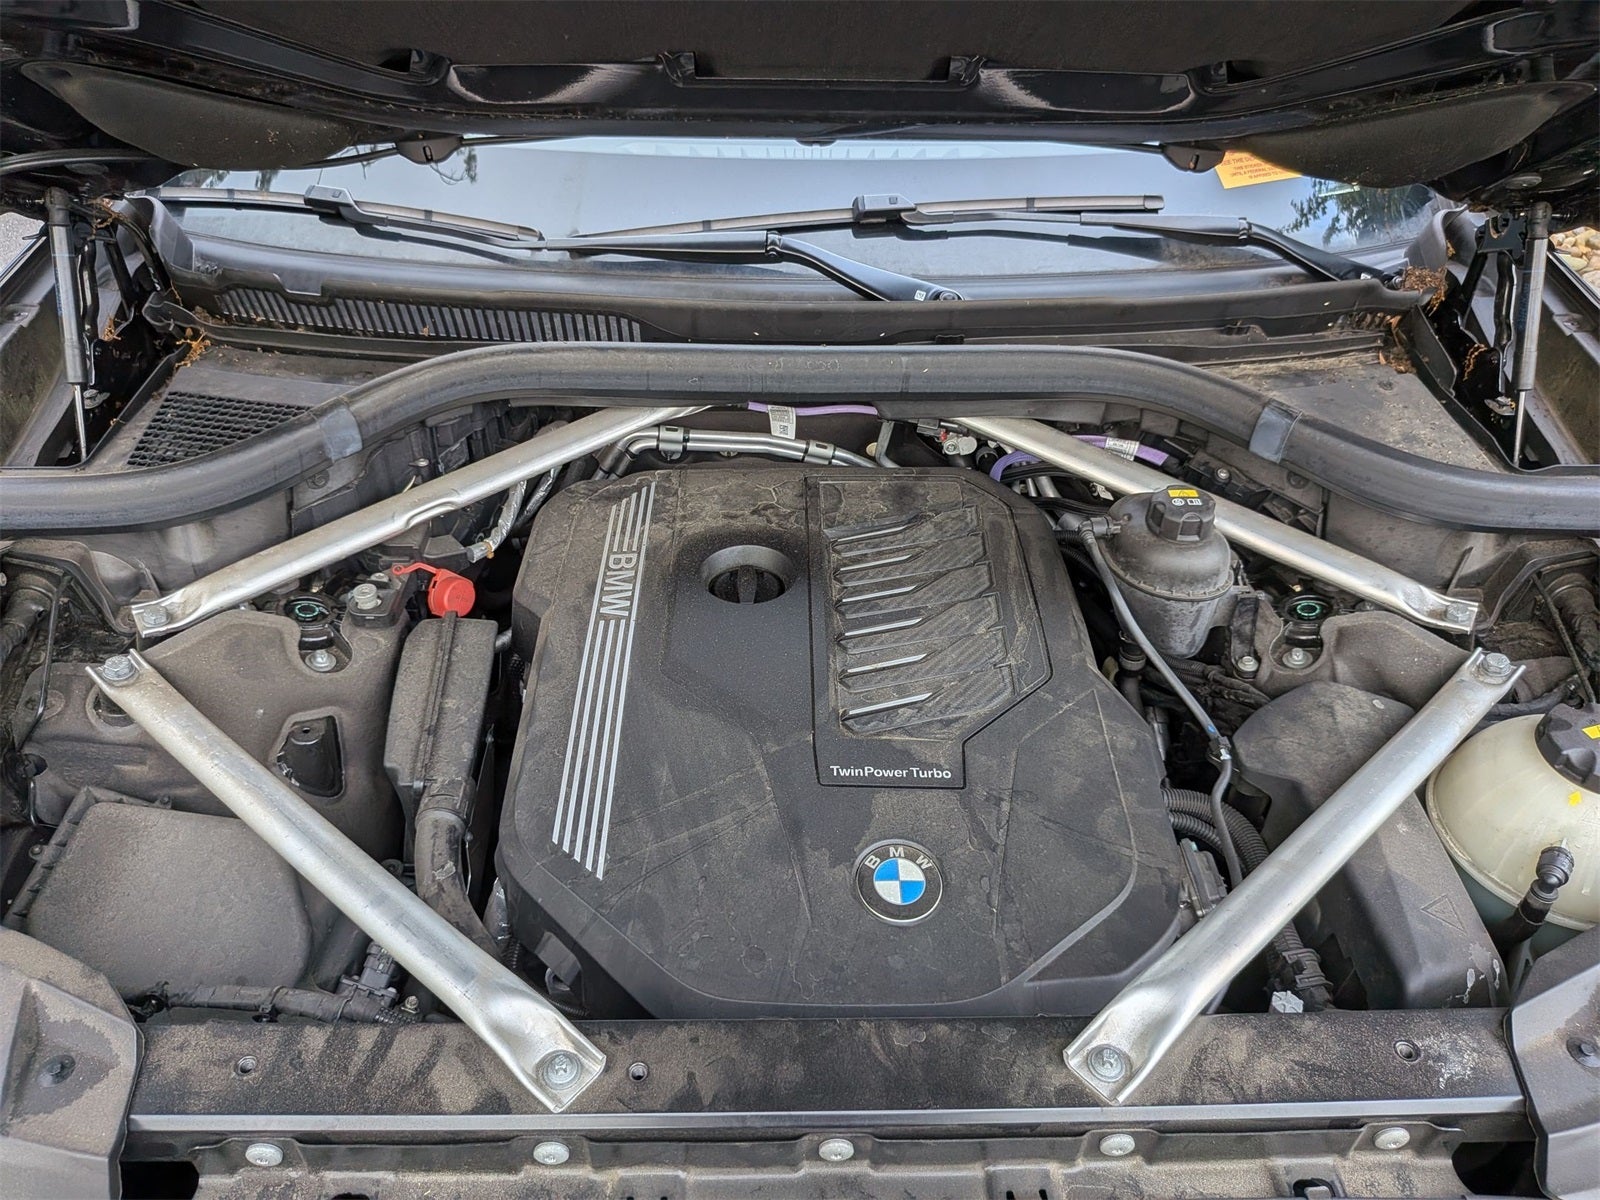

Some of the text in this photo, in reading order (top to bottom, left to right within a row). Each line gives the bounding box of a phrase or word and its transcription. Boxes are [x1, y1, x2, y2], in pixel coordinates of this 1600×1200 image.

[600, 553, 638, 616] BMW
[830, 765, 952, 779] TwinPower Turbo
[864, 846, 933, 870] BMW
